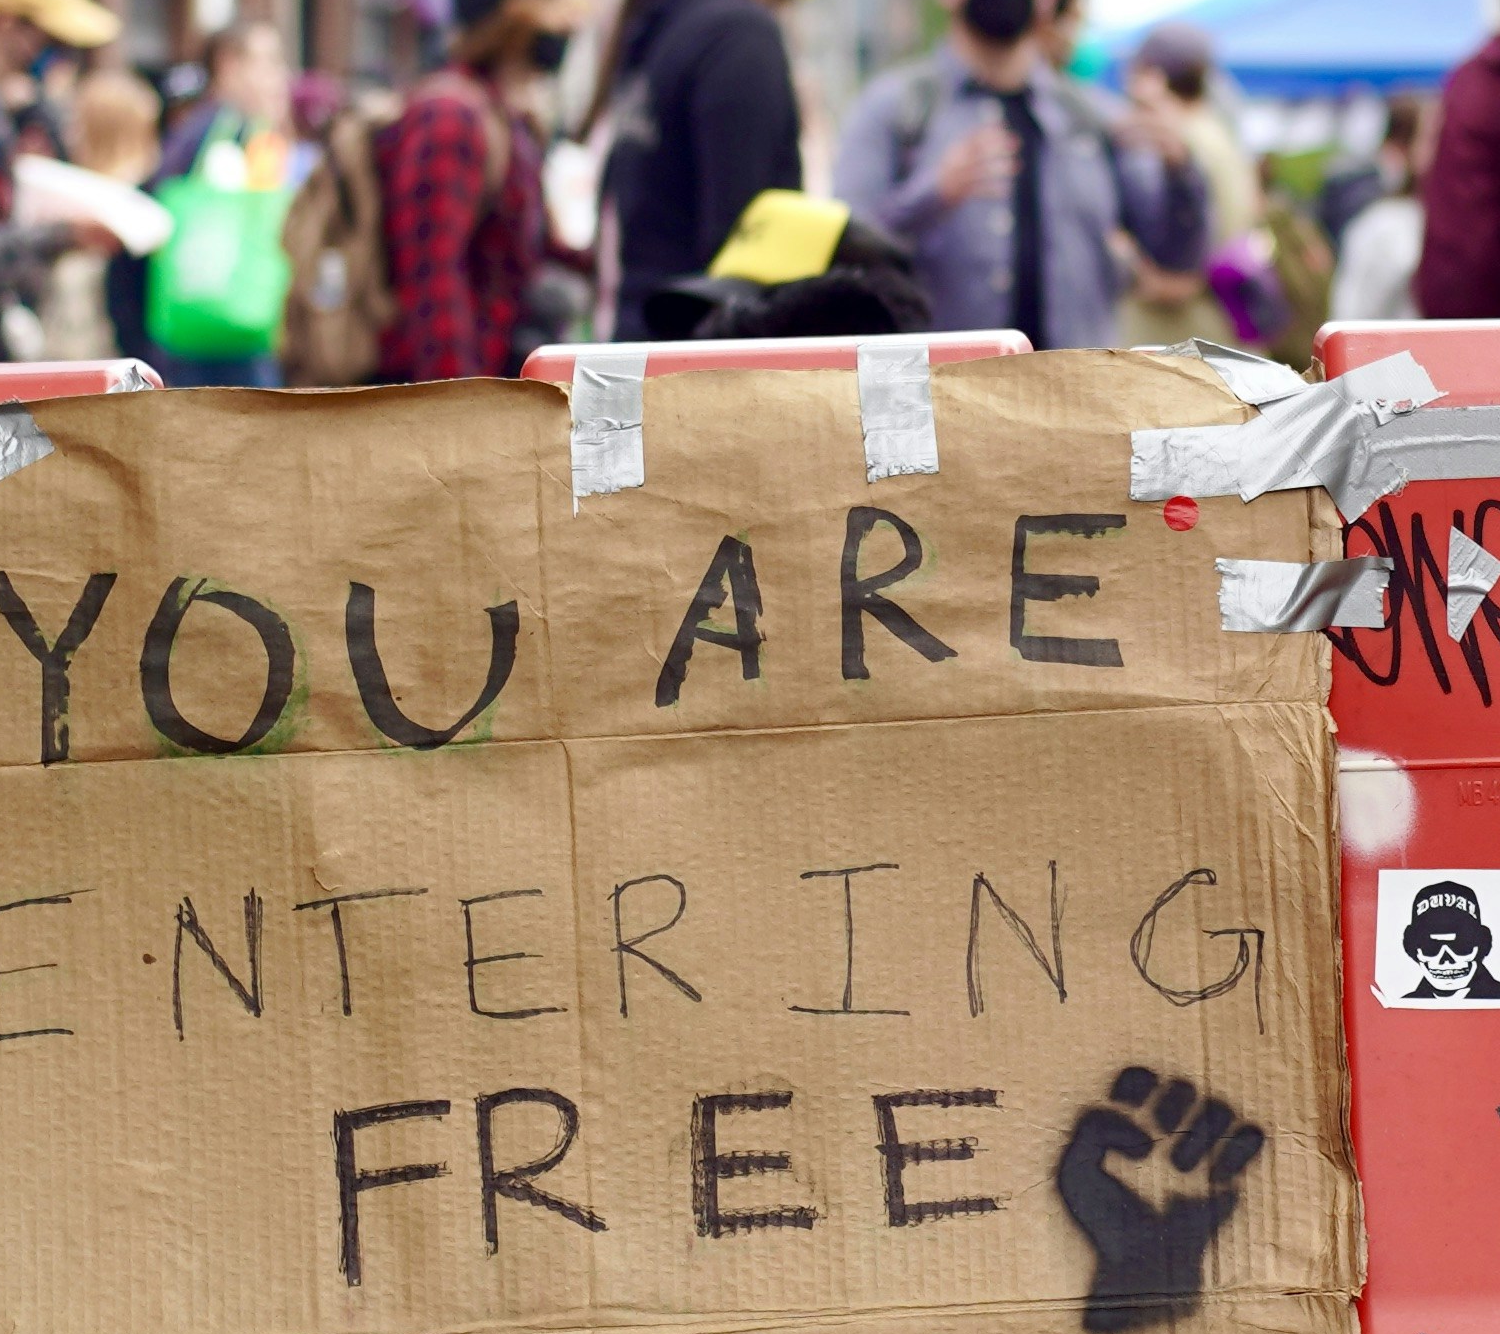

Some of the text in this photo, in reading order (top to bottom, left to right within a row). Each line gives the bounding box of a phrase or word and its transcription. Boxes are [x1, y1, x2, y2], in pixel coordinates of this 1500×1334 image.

[653, 503, 1131, 709] ARE
[1416, 893, 1478, 920] DUVAL
[332, 1085, 1007, 1288] FREE
